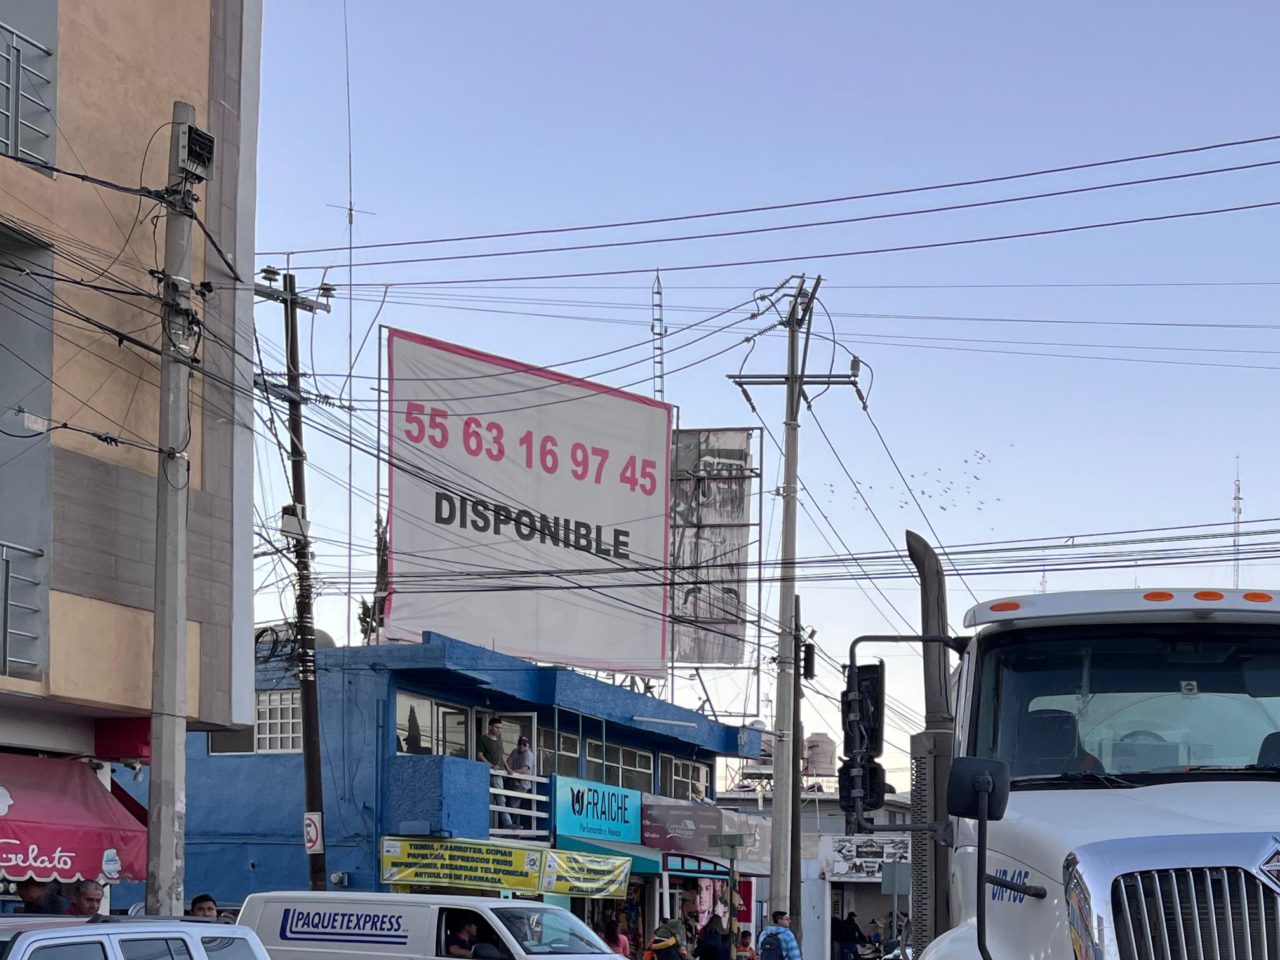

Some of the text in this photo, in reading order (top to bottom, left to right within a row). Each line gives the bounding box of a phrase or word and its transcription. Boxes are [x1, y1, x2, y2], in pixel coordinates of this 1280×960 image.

[404, 401, 449, 449] 55
[462, 416, 505, 462] 63
[519, 430, 559, 474] 16
[571, 442, 609, 485] 97
[619, 455, 657, 496] 45
[435, 492, 630, 559] DISPONIBLE
[586, 788, 629, 824] FRAICHE
[486, 848, 513, 857] COPIAS
[295, 911, 403, 932] PAQUETEXPRESS
